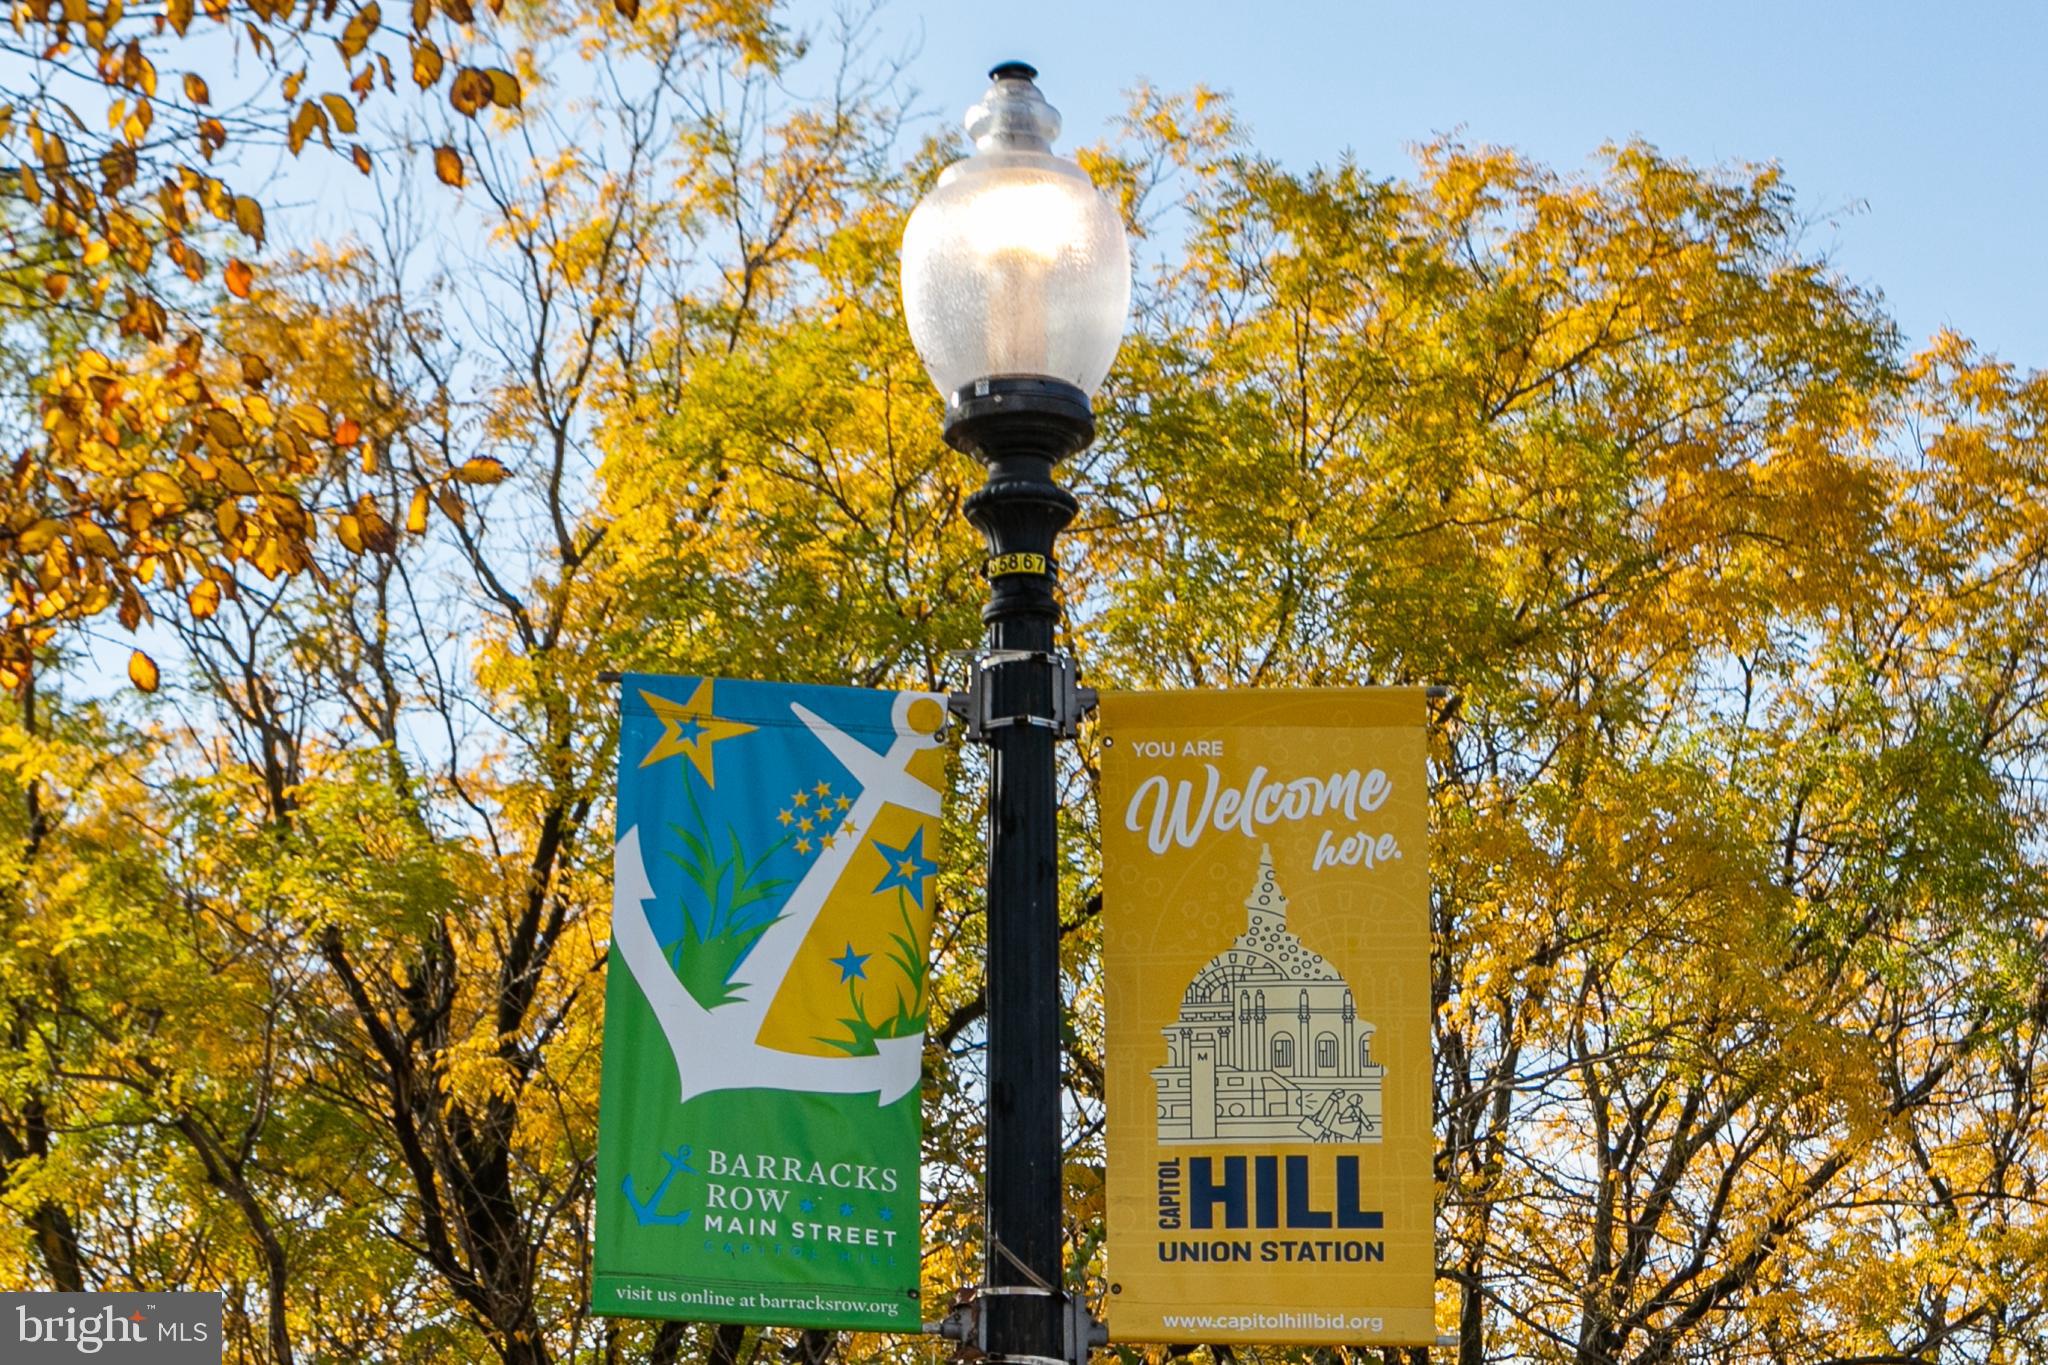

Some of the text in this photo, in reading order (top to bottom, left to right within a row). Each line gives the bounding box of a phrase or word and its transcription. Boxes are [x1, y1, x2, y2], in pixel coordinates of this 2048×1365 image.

[1132, 741, 1223, 757] YOU ARE
[1125, 764, 1392, 855] Welcome
[1312, 830, 1402, 871] here.
[708, 1149, 898, 1193] BARRACKS
[706, 1183, 791, 1213] ROW
[1158, 1157, 1181, 1230] CAPITOL
[1189, 1155, 1384, 1229] HILL
[704, 1215, 897, 1247] MAIN STREET
[1158, 1241, 1384, 1262] UNION STATION
[616, 1286, 898, 1317] visit us online at barracksrow.org
[1163, 1312, 1384, 1333] www.capitolhillbid.org
